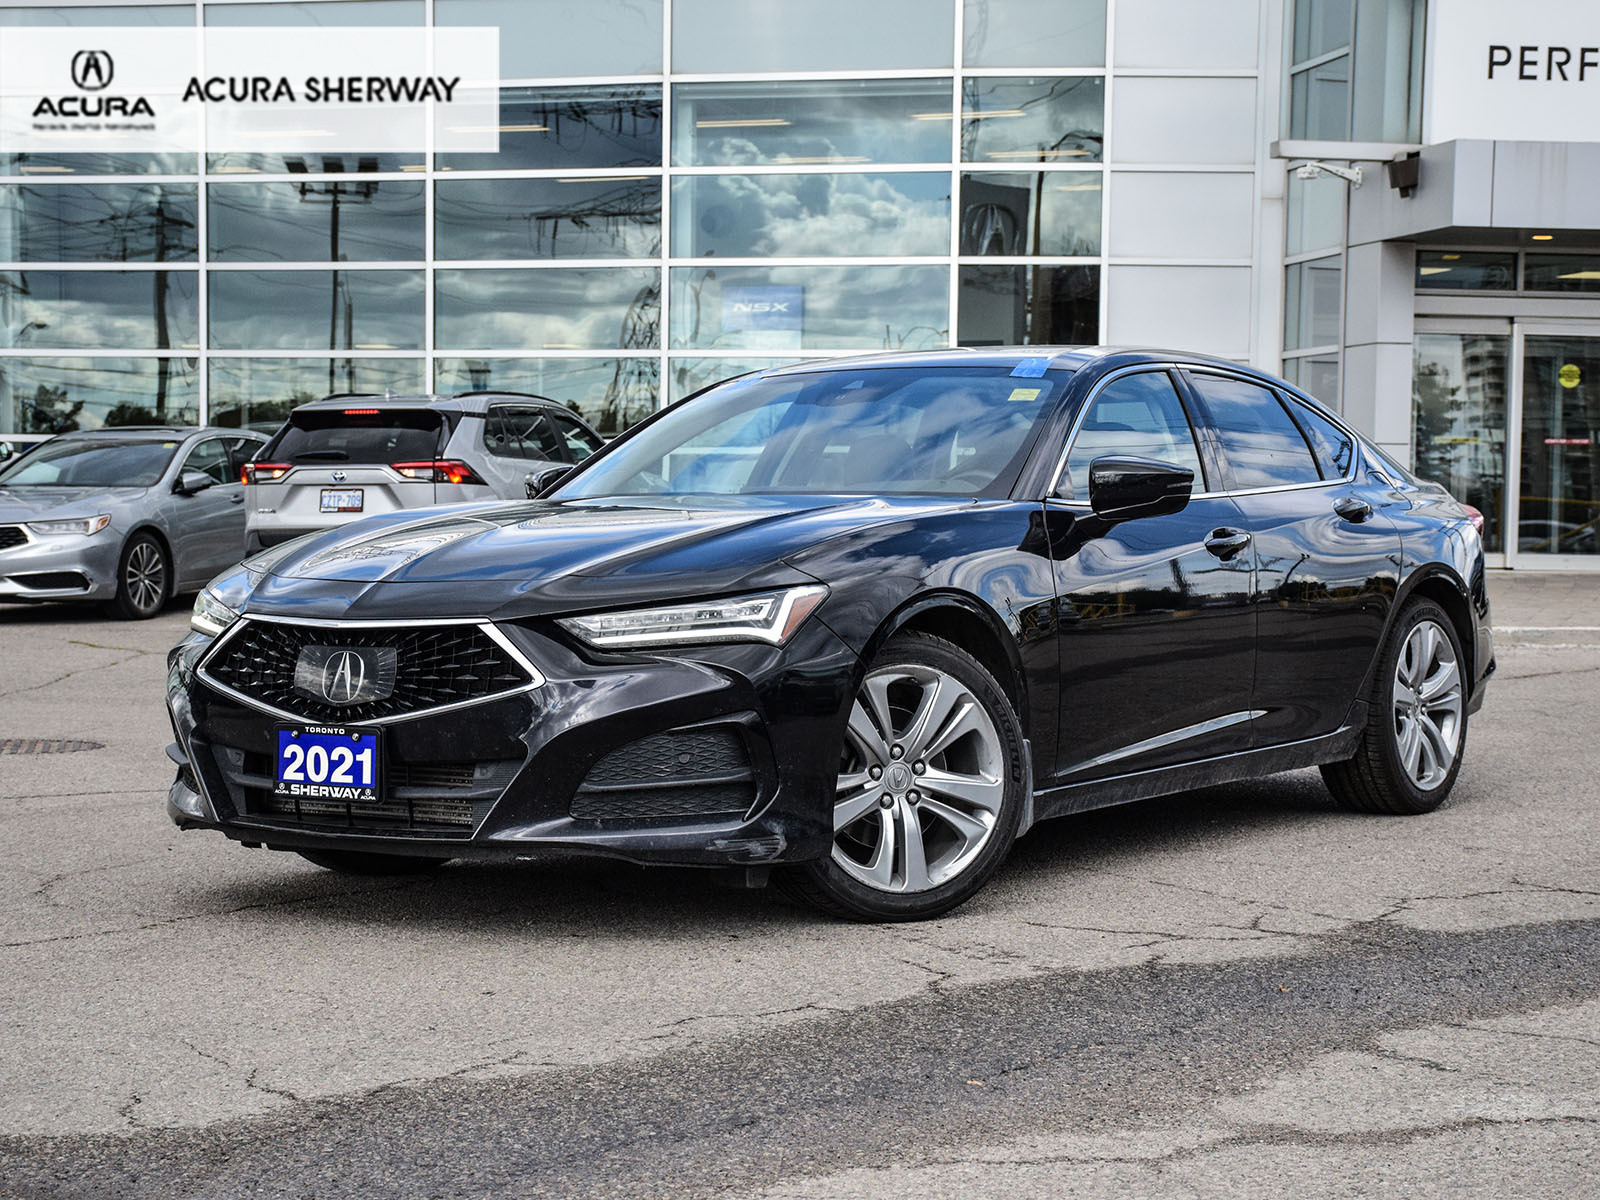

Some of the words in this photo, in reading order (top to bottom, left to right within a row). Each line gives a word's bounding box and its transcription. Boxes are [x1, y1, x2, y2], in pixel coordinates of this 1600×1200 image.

[1487, 44, 1600, 82] PERF
[733, 302, 789, 313] NSX
[305, 726, 345, 735] TORONTO
[282, 744, 372, 785] 2021
[290, 784, 361, 799] SHERWAY
